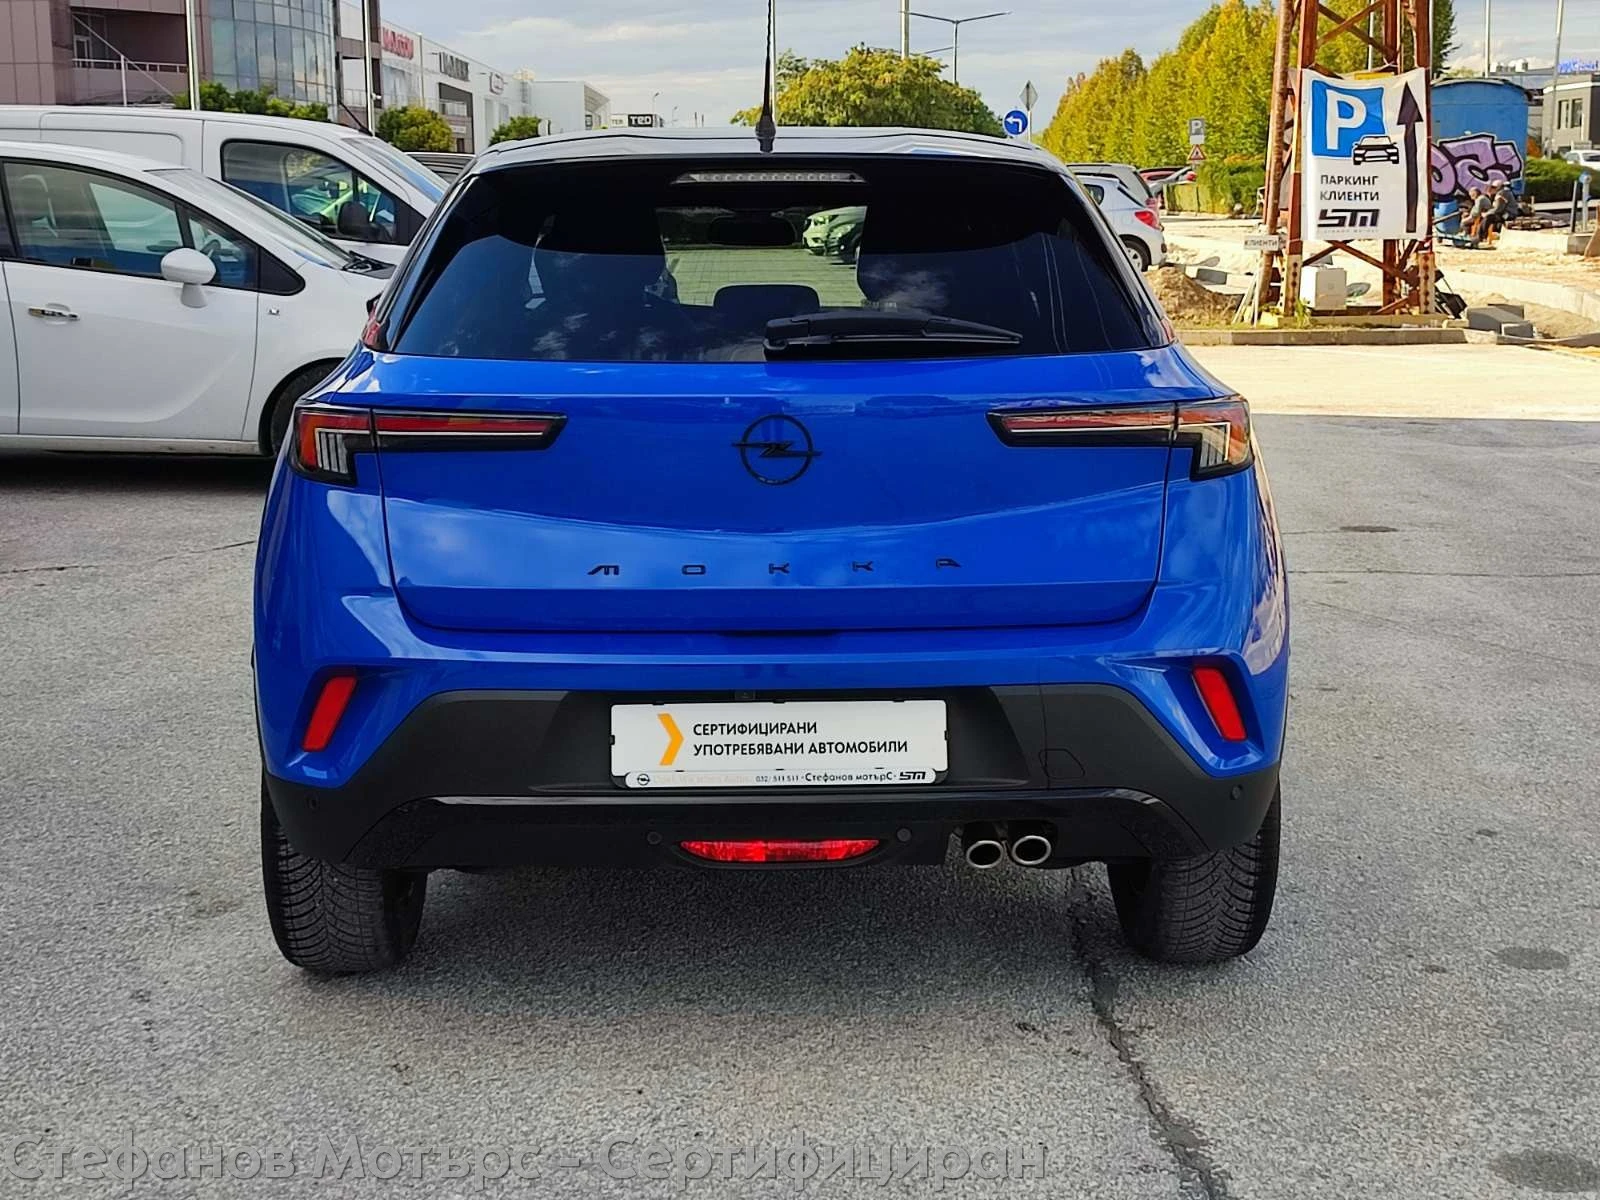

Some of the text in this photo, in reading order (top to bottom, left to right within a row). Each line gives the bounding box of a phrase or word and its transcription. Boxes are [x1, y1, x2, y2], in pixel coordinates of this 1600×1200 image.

[1326, 88, 1367, 150] P
[1320, 174, 1379, 186] ПАРКИНГ
[1319, 191, 1380, 201] КЛИЕНТИ
[692, 721, 818, 736] СЕРТИФИЦИРАНИ
[693, 740, 908, 756] УПОТРЕБЯВАНИ АВТОМОБИЛИ
